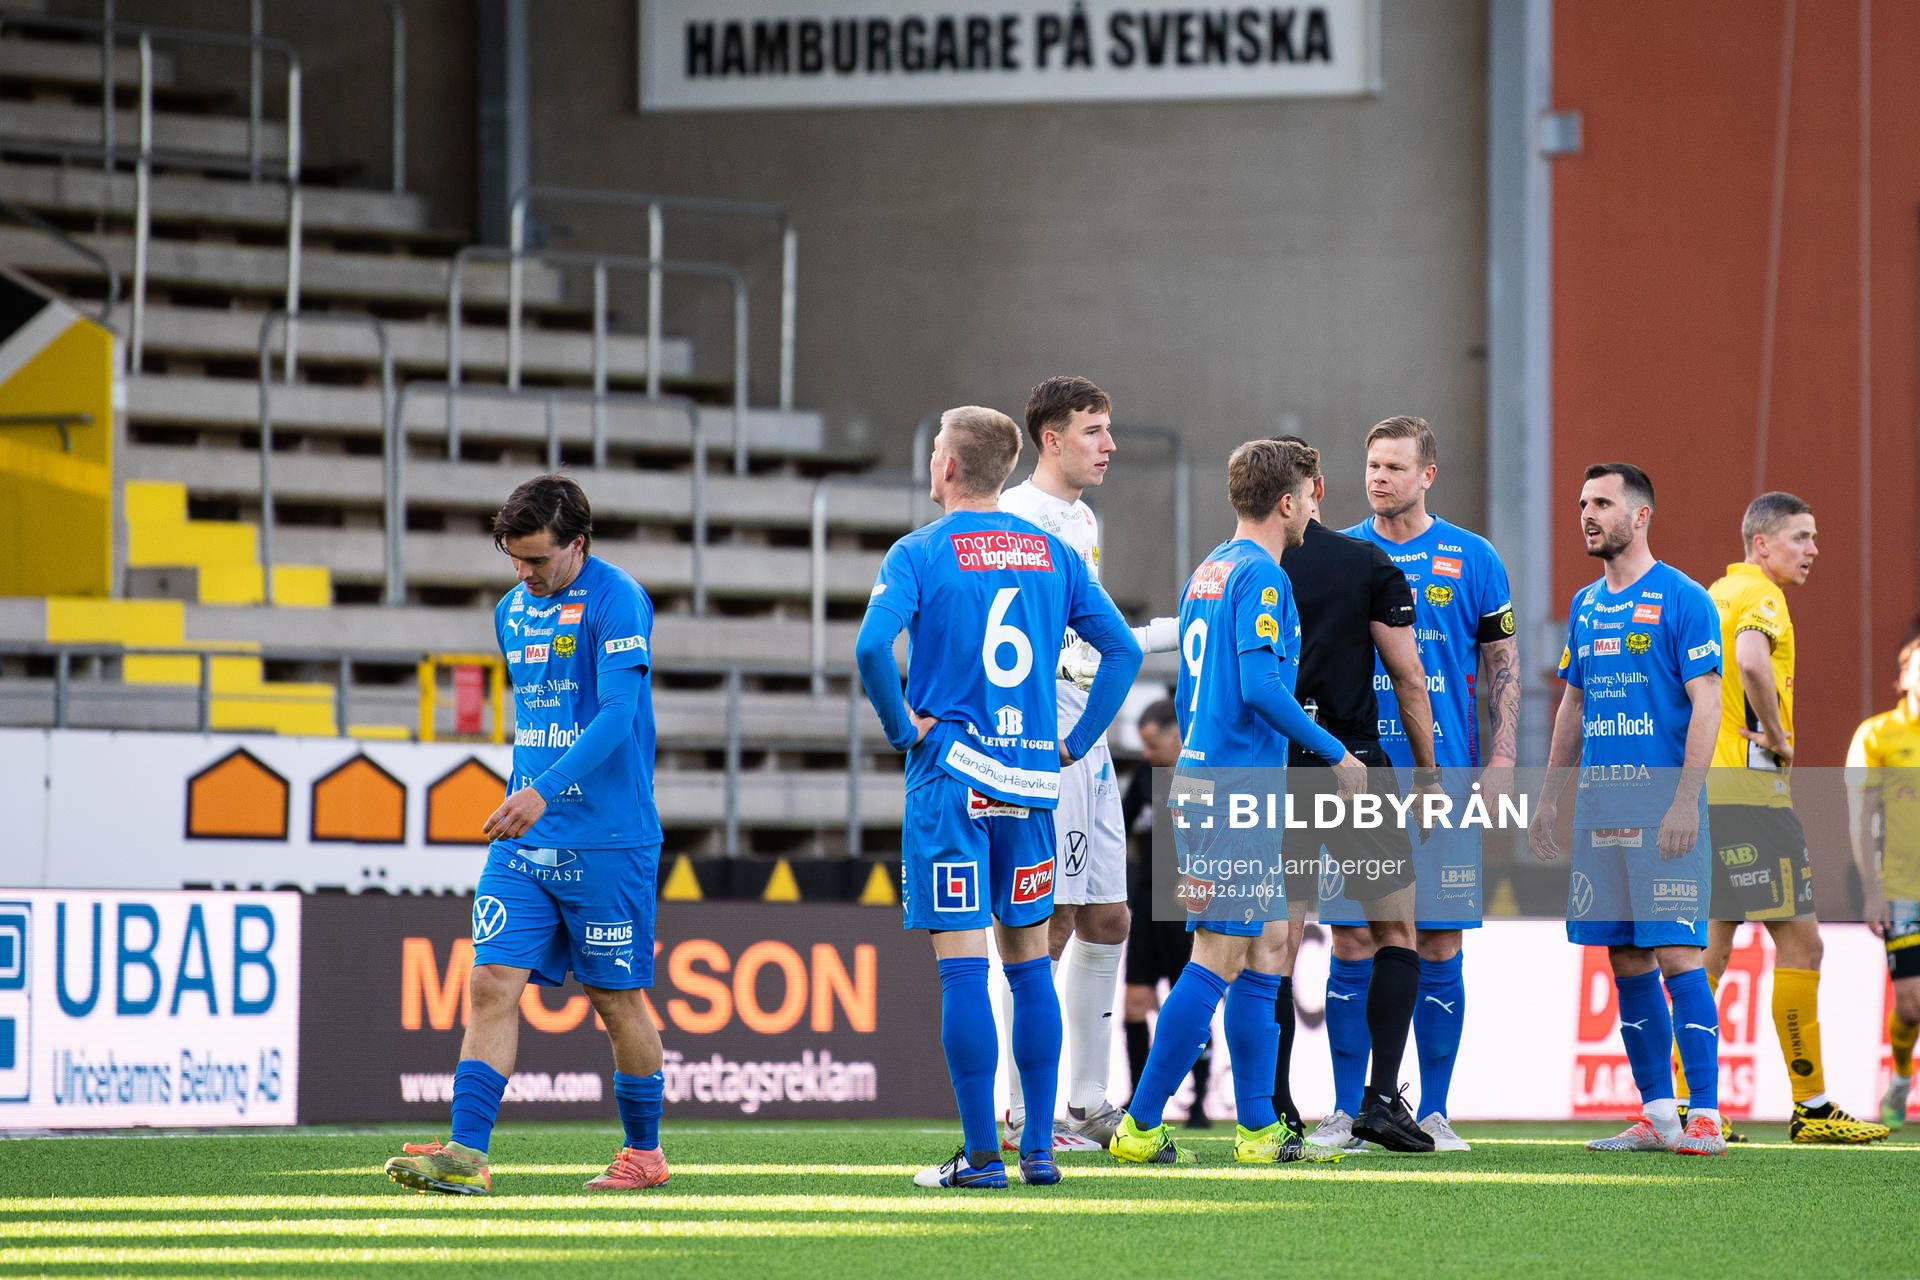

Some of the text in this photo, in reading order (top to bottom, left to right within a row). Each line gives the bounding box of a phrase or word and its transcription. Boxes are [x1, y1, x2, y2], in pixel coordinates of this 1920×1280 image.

[685, 1, 1333, 78] HAMBURGARE PÅ SVENSKA
[954, 532, 1046, 555] marching
[959, 552, 980, 566] on
[982, 588, 1033, 688] 6
[1595, 640, 1620, 652] MAXI
[1183, 618, 1208, 712] 9
[1589, 687, 1628, 701] Sparbank
[1618, 712, 1654, 737] Rock
[1019, 869, 1052, 896] EXTRA
[1653, 884, 1698, 897] LB-HUS
[586, 926, 632, 940] LB-HUS
[55, 903, 277, 1017] UBAB
[1787, 1009, 1802, 1058] VINNERGI
[181, 1050, 247, 1115] Betong
[257, 1050, 281, 1102] AB
[662, 1049, 877, 1113] öretagsreklam
